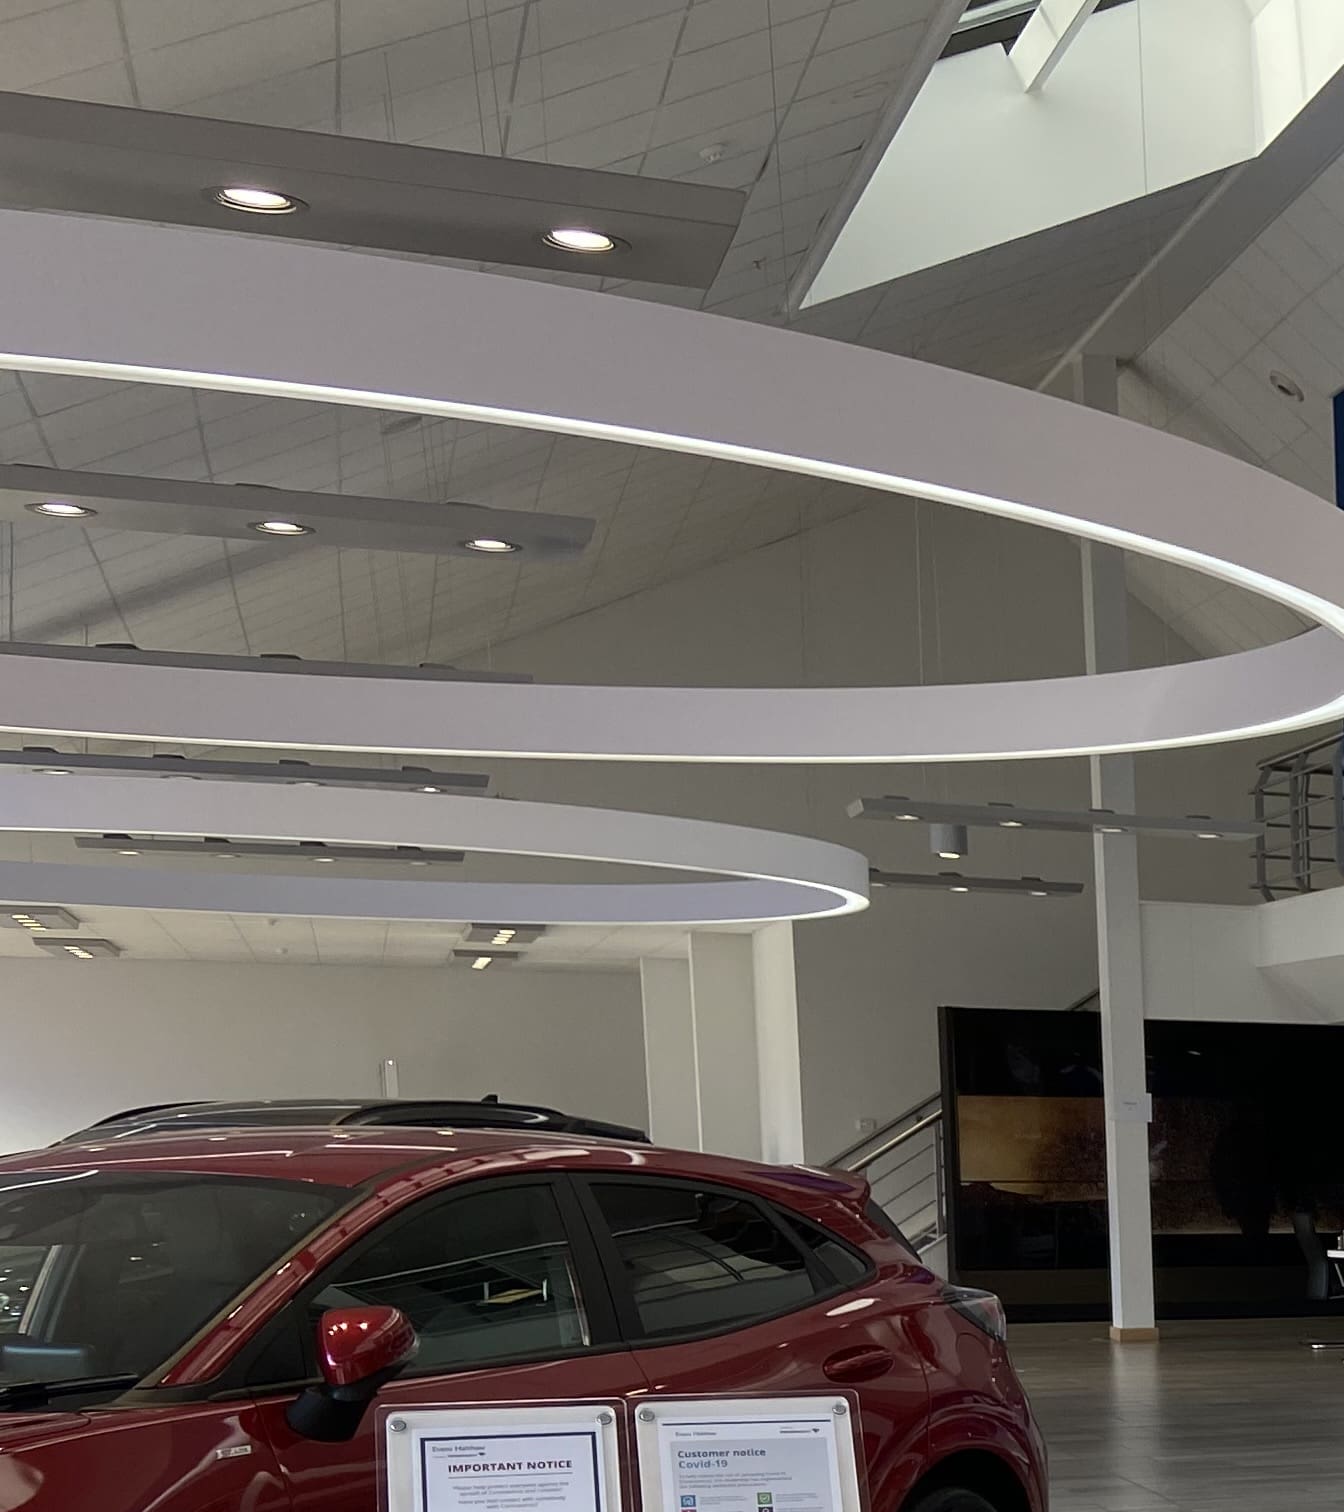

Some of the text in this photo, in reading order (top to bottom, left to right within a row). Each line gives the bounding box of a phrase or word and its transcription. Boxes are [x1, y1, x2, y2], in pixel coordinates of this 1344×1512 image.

[678, 1448, 766, 1459] Customer notice
[448, 1460, 573, 1473] IMPORTANT NOTICE
[679, 1459, 728, 1469] Covid-19
